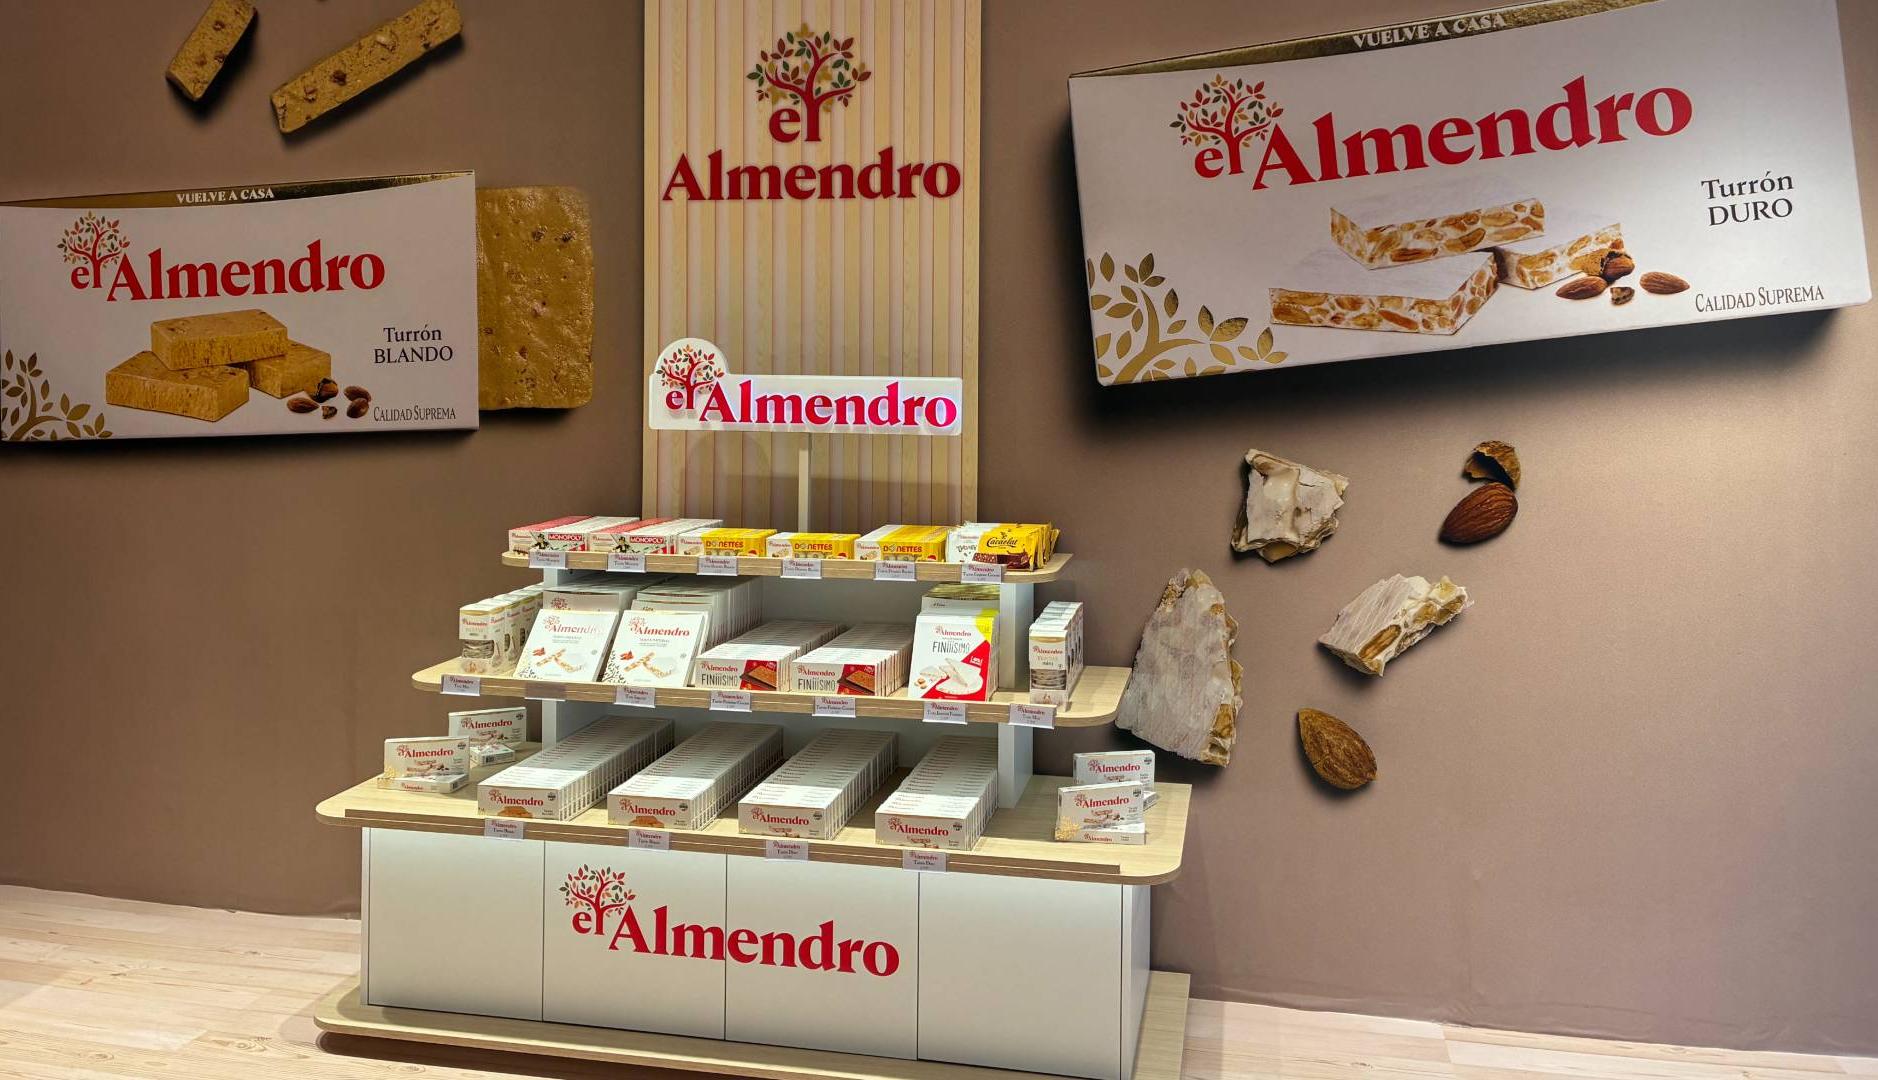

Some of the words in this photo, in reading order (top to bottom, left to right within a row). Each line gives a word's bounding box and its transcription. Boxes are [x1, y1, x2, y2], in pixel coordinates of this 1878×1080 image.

[1353, 24, 1430, 48] VUELVE
[1435, 22, 1450, 37] A
[1453, 13, 1507, 34] CASA
[1252, 75, 1693, 191] Almendro
[662, 146, 961, 201] Almendro
[1701, 171, 1794, 199] Turrón
[176, 191, 226, 204] VUELVE
[228, 190, 238, 201] A
[240, 186, 275, 200] CASA
[1708, 198, 1793, 226] DURO
[106, 239, 386, 301] Almendro
[1695, 292, 1756, 313] CALIDAD
[1758, 285, 1825, 306] SUPREMA
[383, 324, 442, 342] Turrón
[374, 345, 454, 364] BLANDO
[699, 379, 958, 428] Almendro
[373, 406, 412, 422] CALIDAD
[413, 404, 456, 421] SUPREMA
[549, 533, 582, 541] MONOPOLY
[630, 536, 664, 544] MONOPOLY
[470, 719, 513, 729] Almendro
[405, 748, 454, 758] Almendro
[1096, 763, 1141, 773] Almendro
[497, 796, 544, 806] Almendro
[1082, 797, 1129, 808] Almendro
[628, 805, 676, 816] Almendro
[760, 814, 809, 825] Almendro
[897, 824, 949, 836] Almendro
[608, 905, 900, 977] Almendro
